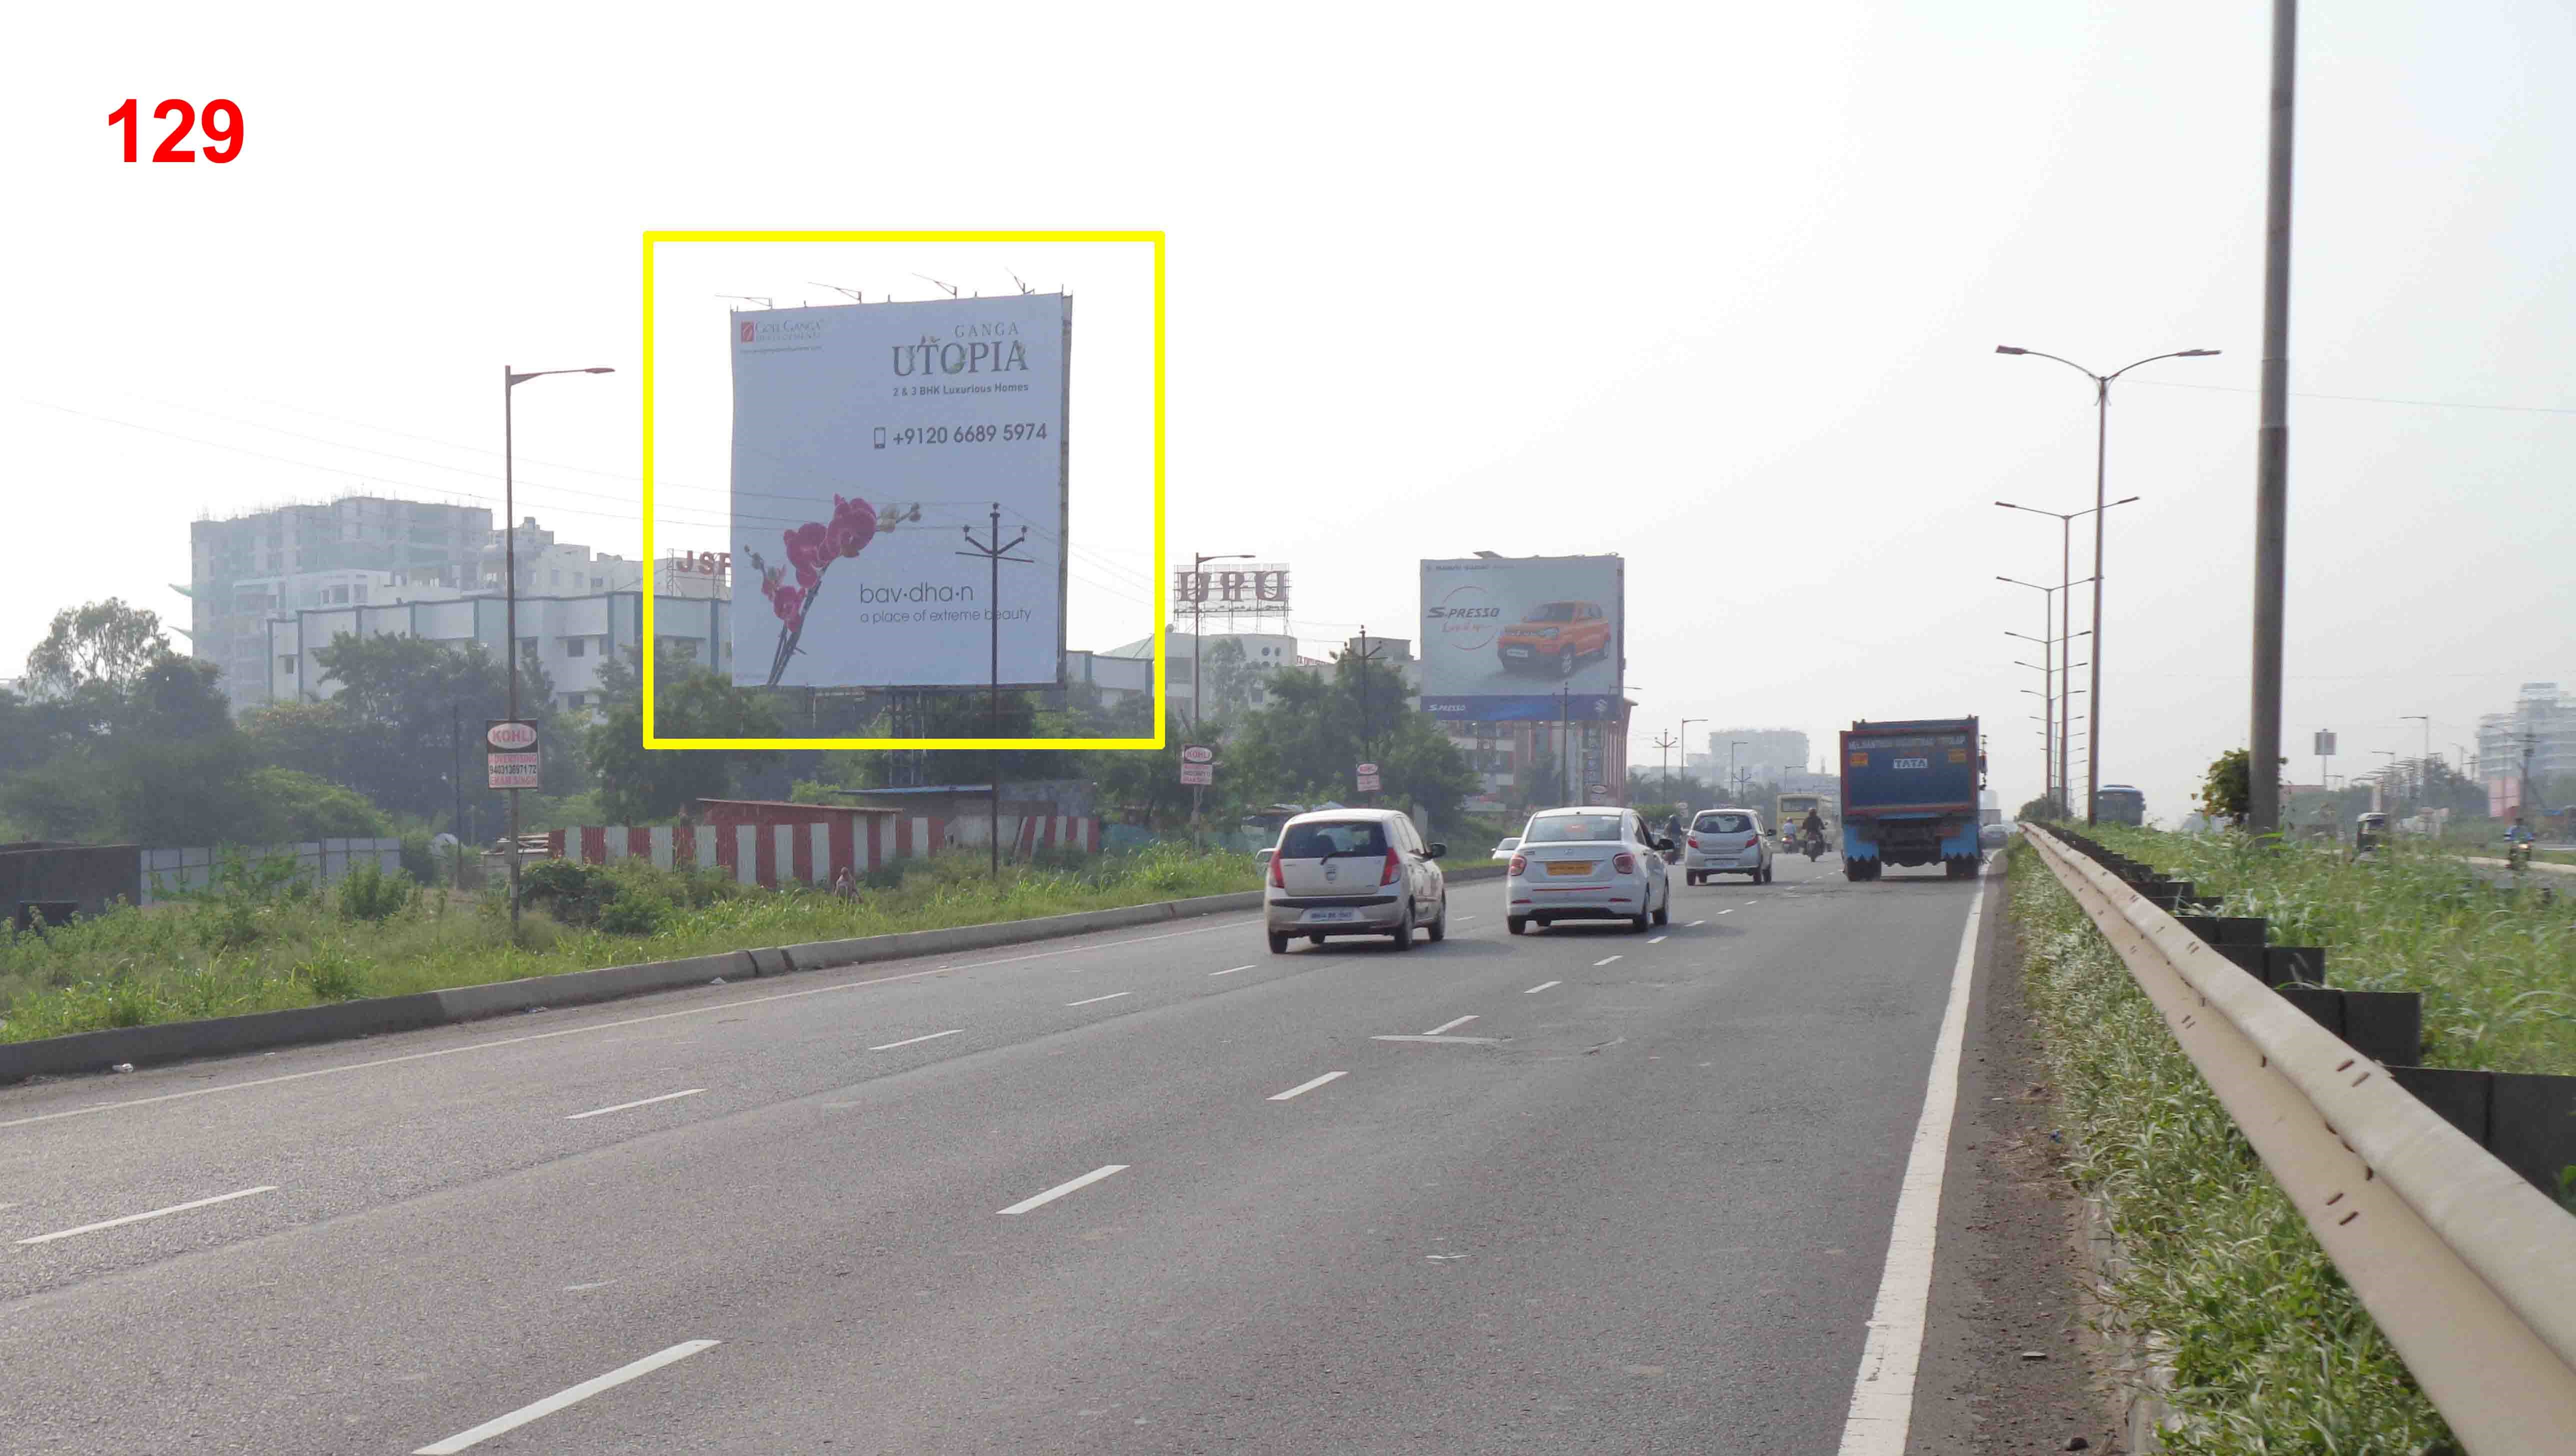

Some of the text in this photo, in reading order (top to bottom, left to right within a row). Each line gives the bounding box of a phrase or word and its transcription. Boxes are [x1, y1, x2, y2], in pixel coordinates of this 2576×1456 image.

[954, 321, 1020, 338] GANGA
[892, 339, 1030, 376] UTOPIA
[892, 382, 1029, 397] 2 & 3 BHK Luxurious Homes
[893, 423, 1048, 445] +9120 6689 5974
[860, 608, 1032, 624] a place of extreme beauty
[492, 728, 534, 743] KOHLI
[1894, 759, 1927, 768] TATA
